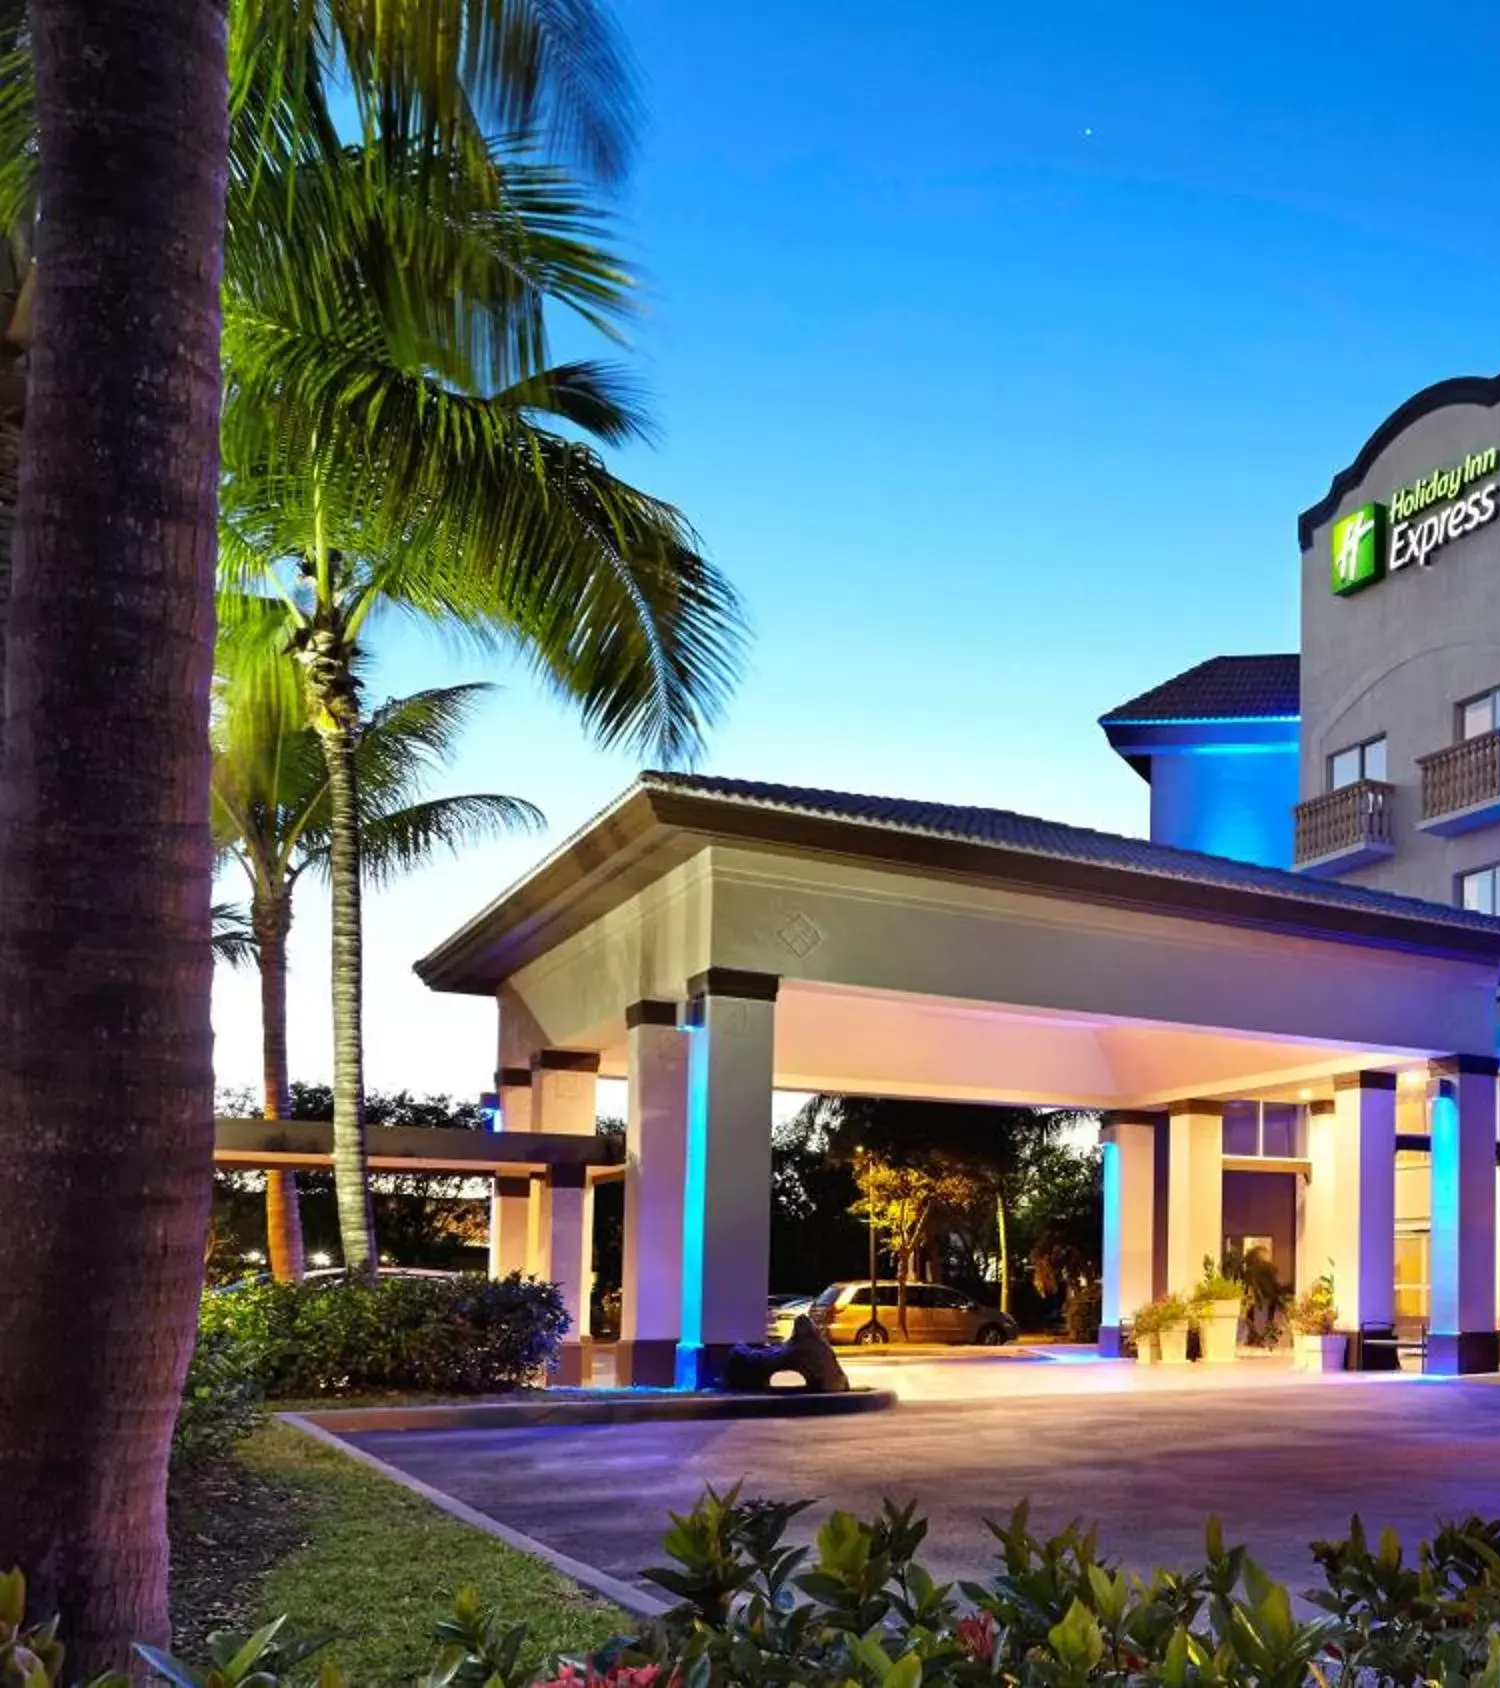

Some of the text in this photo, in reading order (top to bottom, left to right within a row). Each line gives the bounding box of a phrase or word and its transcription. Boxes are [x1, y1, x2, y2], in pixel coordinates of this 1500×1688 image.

[1389, 447, 1497, 524] Holiday Inn
[1389, 483, 1497, 571] Express
